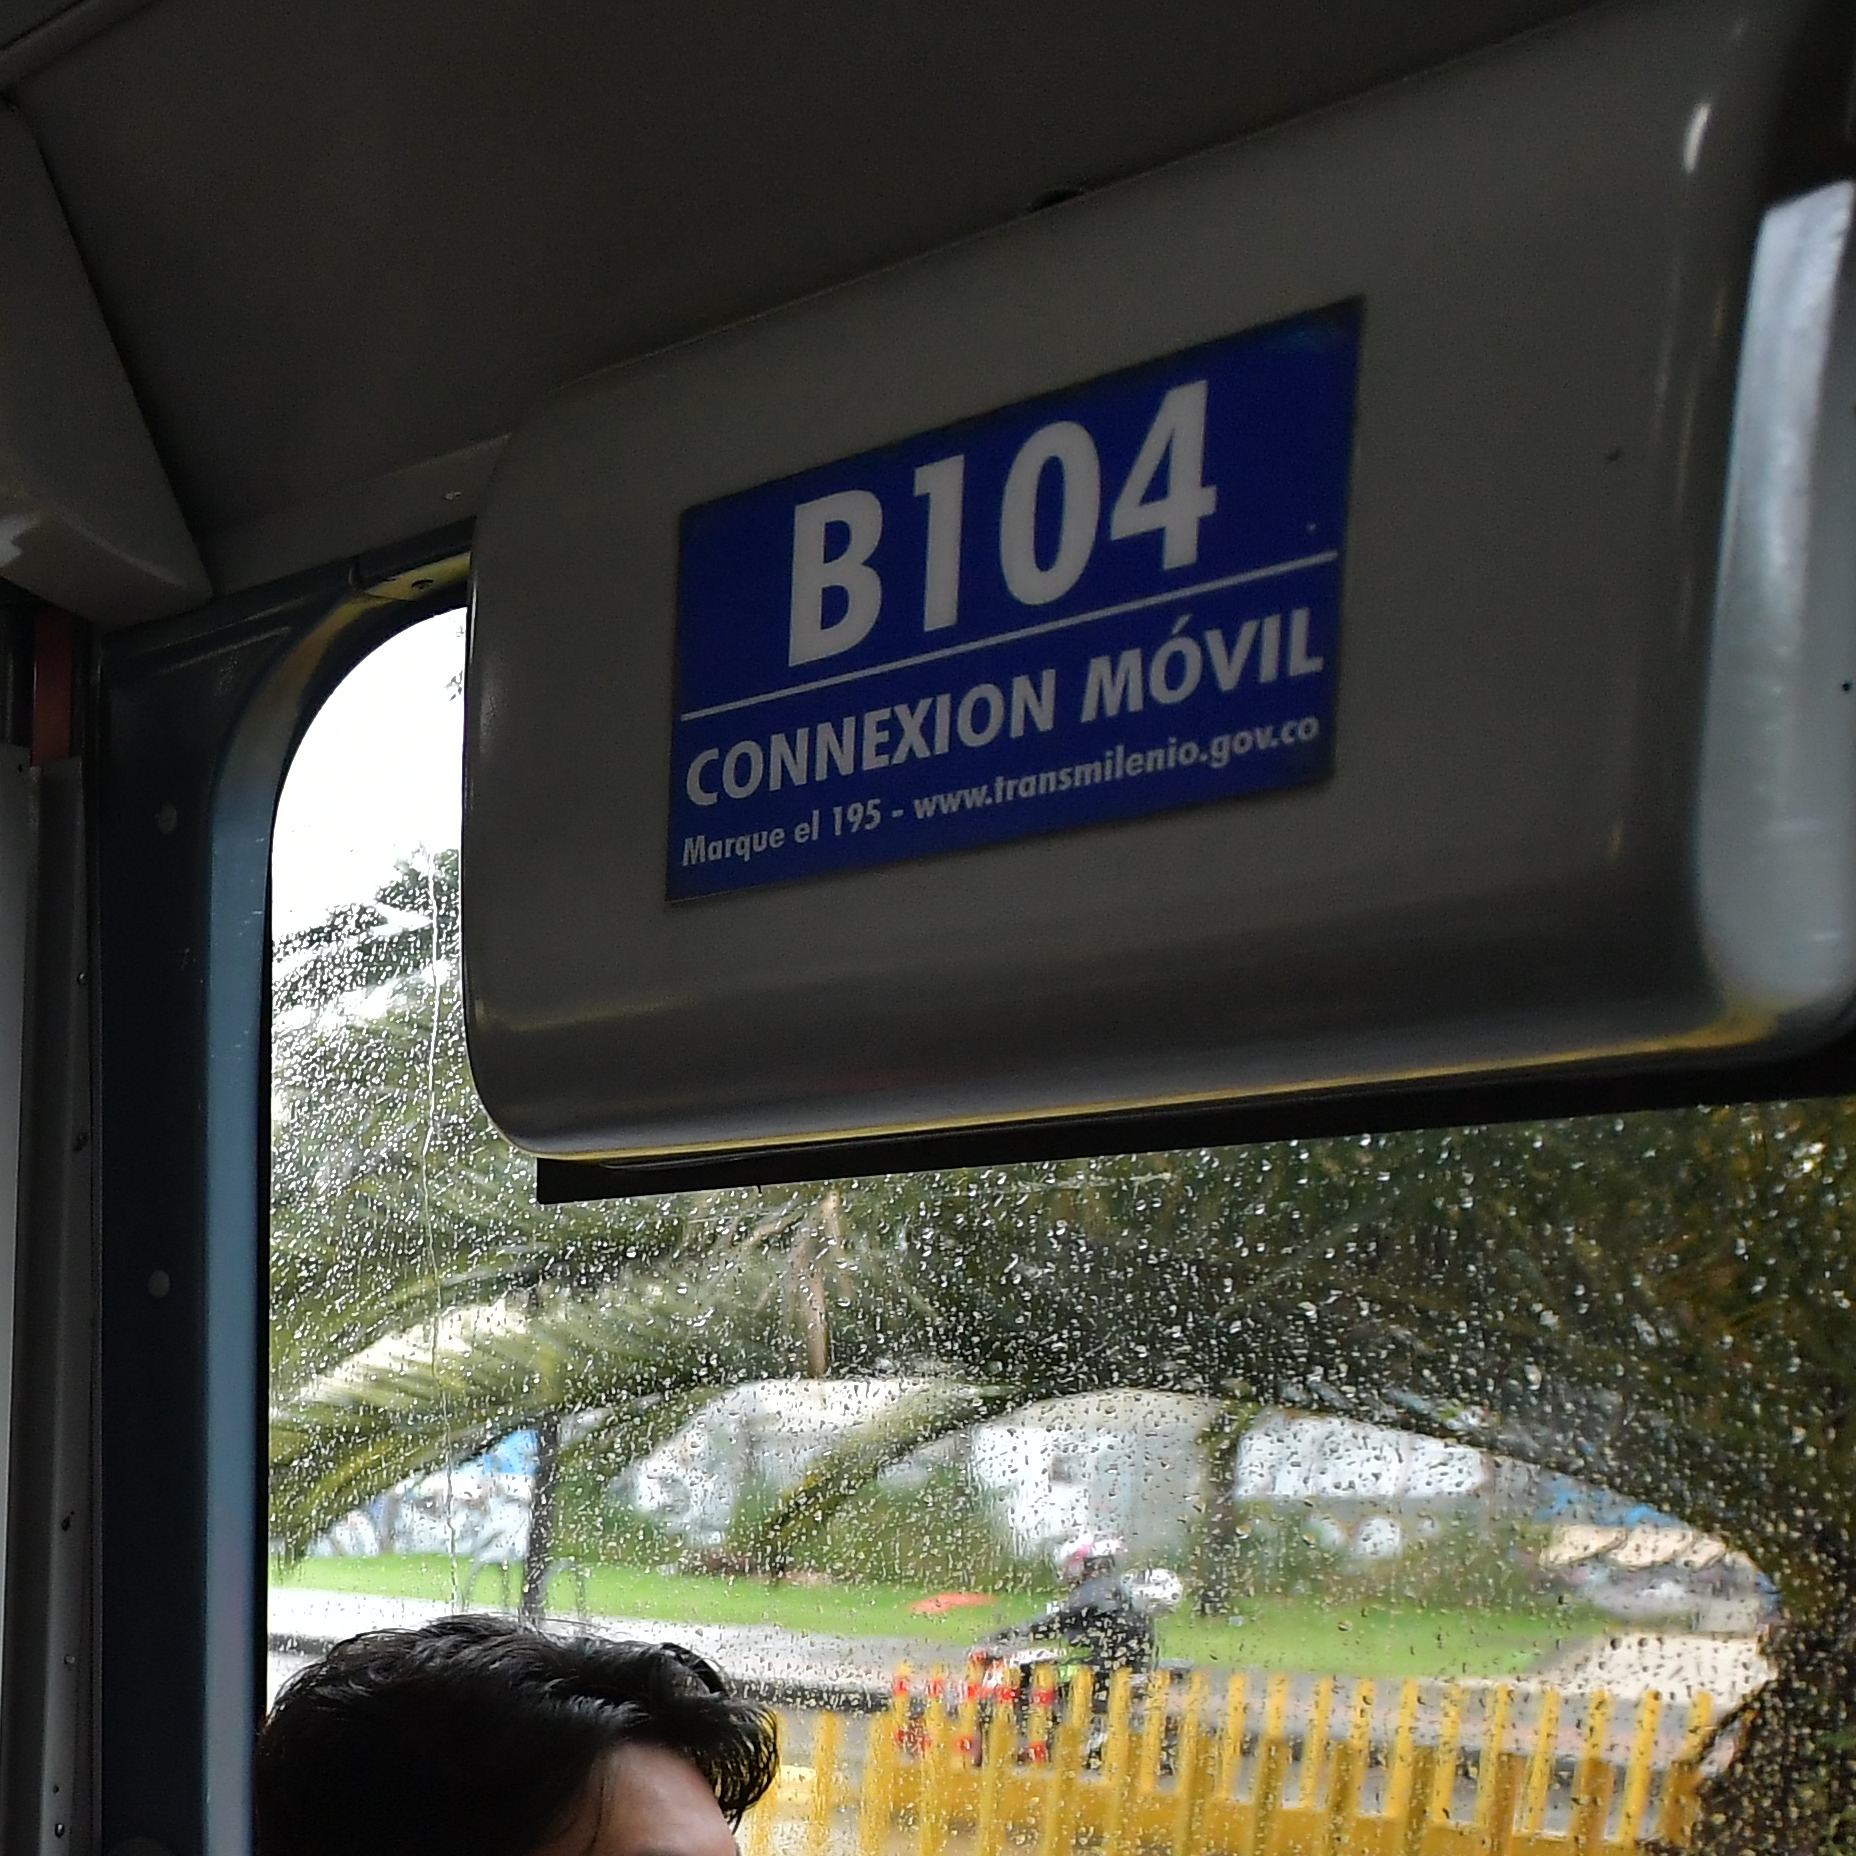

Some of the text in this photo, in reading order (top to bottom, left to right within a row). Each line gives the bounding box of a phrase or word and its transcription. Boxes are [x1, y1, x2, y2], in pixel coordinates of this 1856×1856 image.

[788, 379, 1217, 667] B104
[682, 823, 786, 866] Marque
[794, 809, 820, 842] el
[833, 799, 882, 838] 195
[914, 716, 1319, 821] www.transmilenio.gov.co
[685, 606, 1323, 805] CONNEXION MÓVIL
